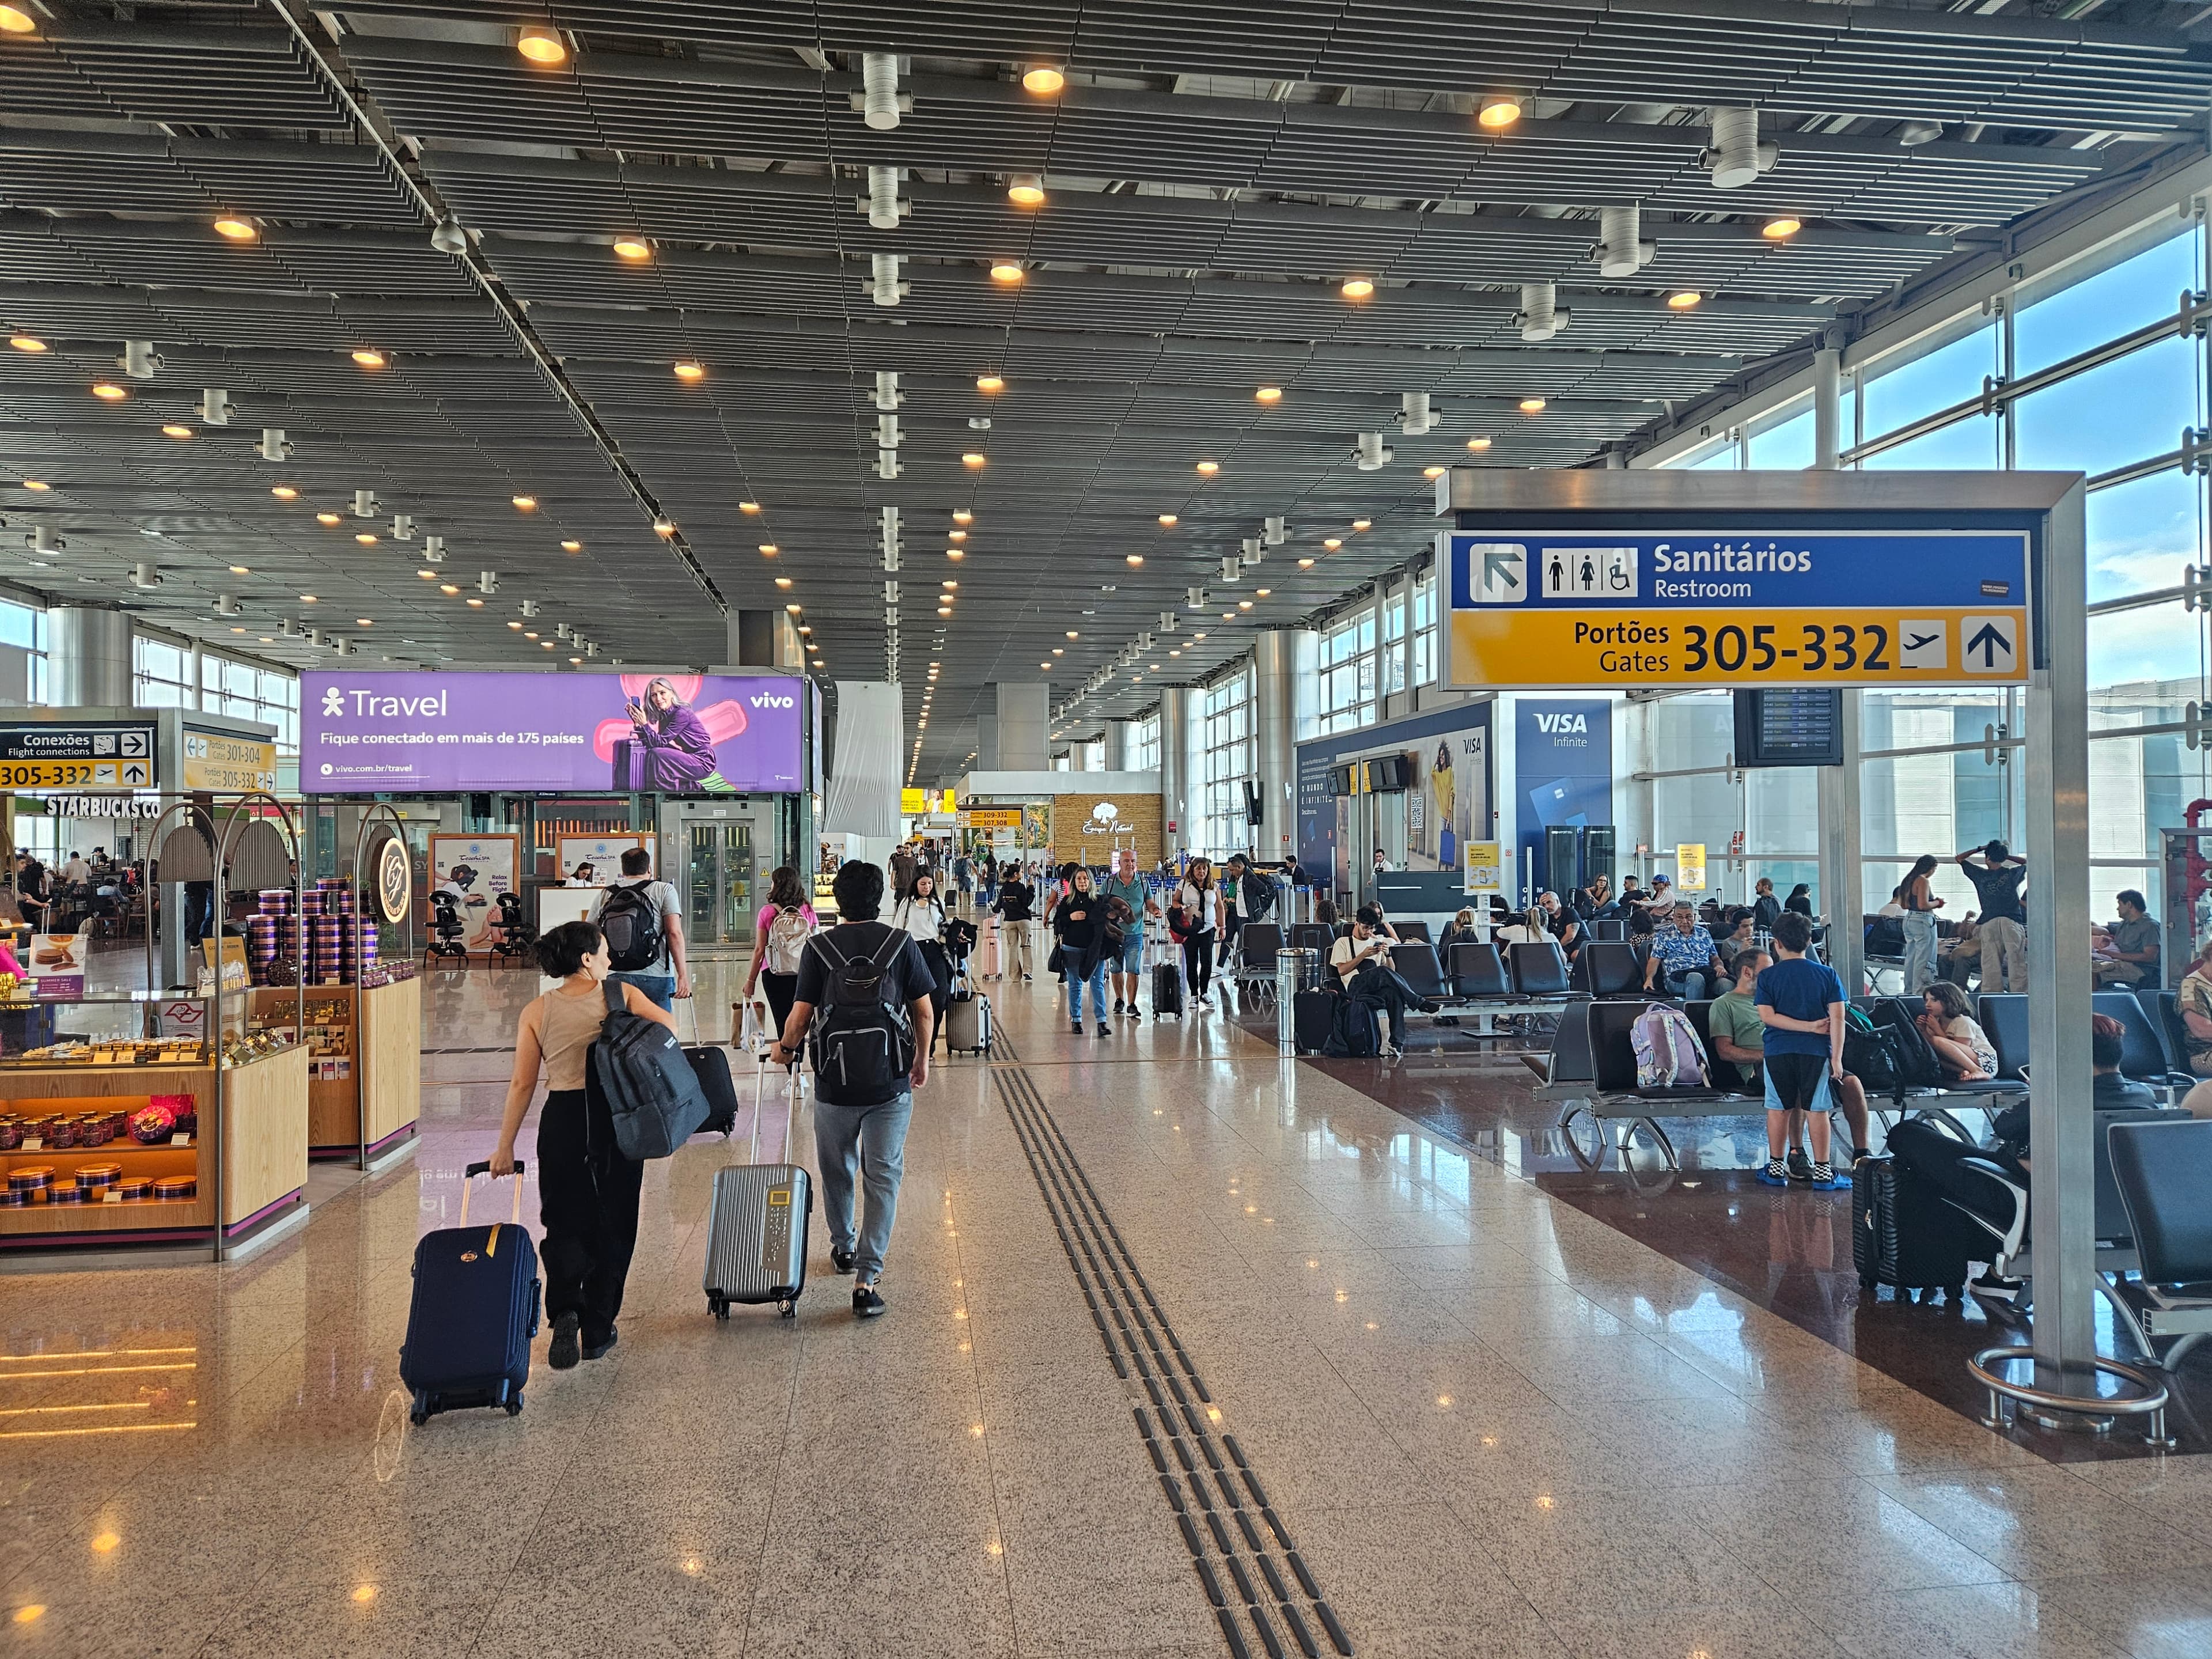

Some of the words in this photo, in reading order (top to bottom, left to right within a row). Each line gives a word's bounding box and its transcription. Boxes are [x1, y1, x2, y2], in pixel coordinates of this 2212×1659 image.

[1654, 541, 1812, 573] Sanitários
[1654, 578, 1752, 599] Restroom
[1574, 620, 1669, 645] Portões
[1683, 624, 1890, 672] 305-332
[1599, 650, 1669, 674] Gates
[348, 688, 447, 717] Travel
[751, 691, 794, 709] vivo
[1532, 713, 1588, 733] VISA
[23, 734, 90, 747] Conexões
[320, 732, 360, 747] Fique
[362, 732, 434, 745] conectado
[437, 734, 459, 744] em
[461, 732, 494, 745] mais
[496, 732, 515, 745] de
[517, 732, 540, 744] 175
[543, 731, 585, 747] países
[1463, 737, 1482, 755] VISA
[1554, 736, 1588, 747] Infinite
[8, 748, 35, 758] Flight
[36, 748, 90, 756] connections
[209, 740, 226, 750] Portões
[227, 744, 260, 764] 301-304
[213, 751, 226, 760] Gates
[1, 766, 92, 785] 305-332
[204, 766, 221, 777] Portões
[223, 770, 255, 789] 305-332
[335, 764, 412, 773] vivo.com.br/travel
[209, 778, 221, 787] Gates
[1306, 783, 1323, 792] MUNDO
[47, 796, 141, 819] STARBUCKS
